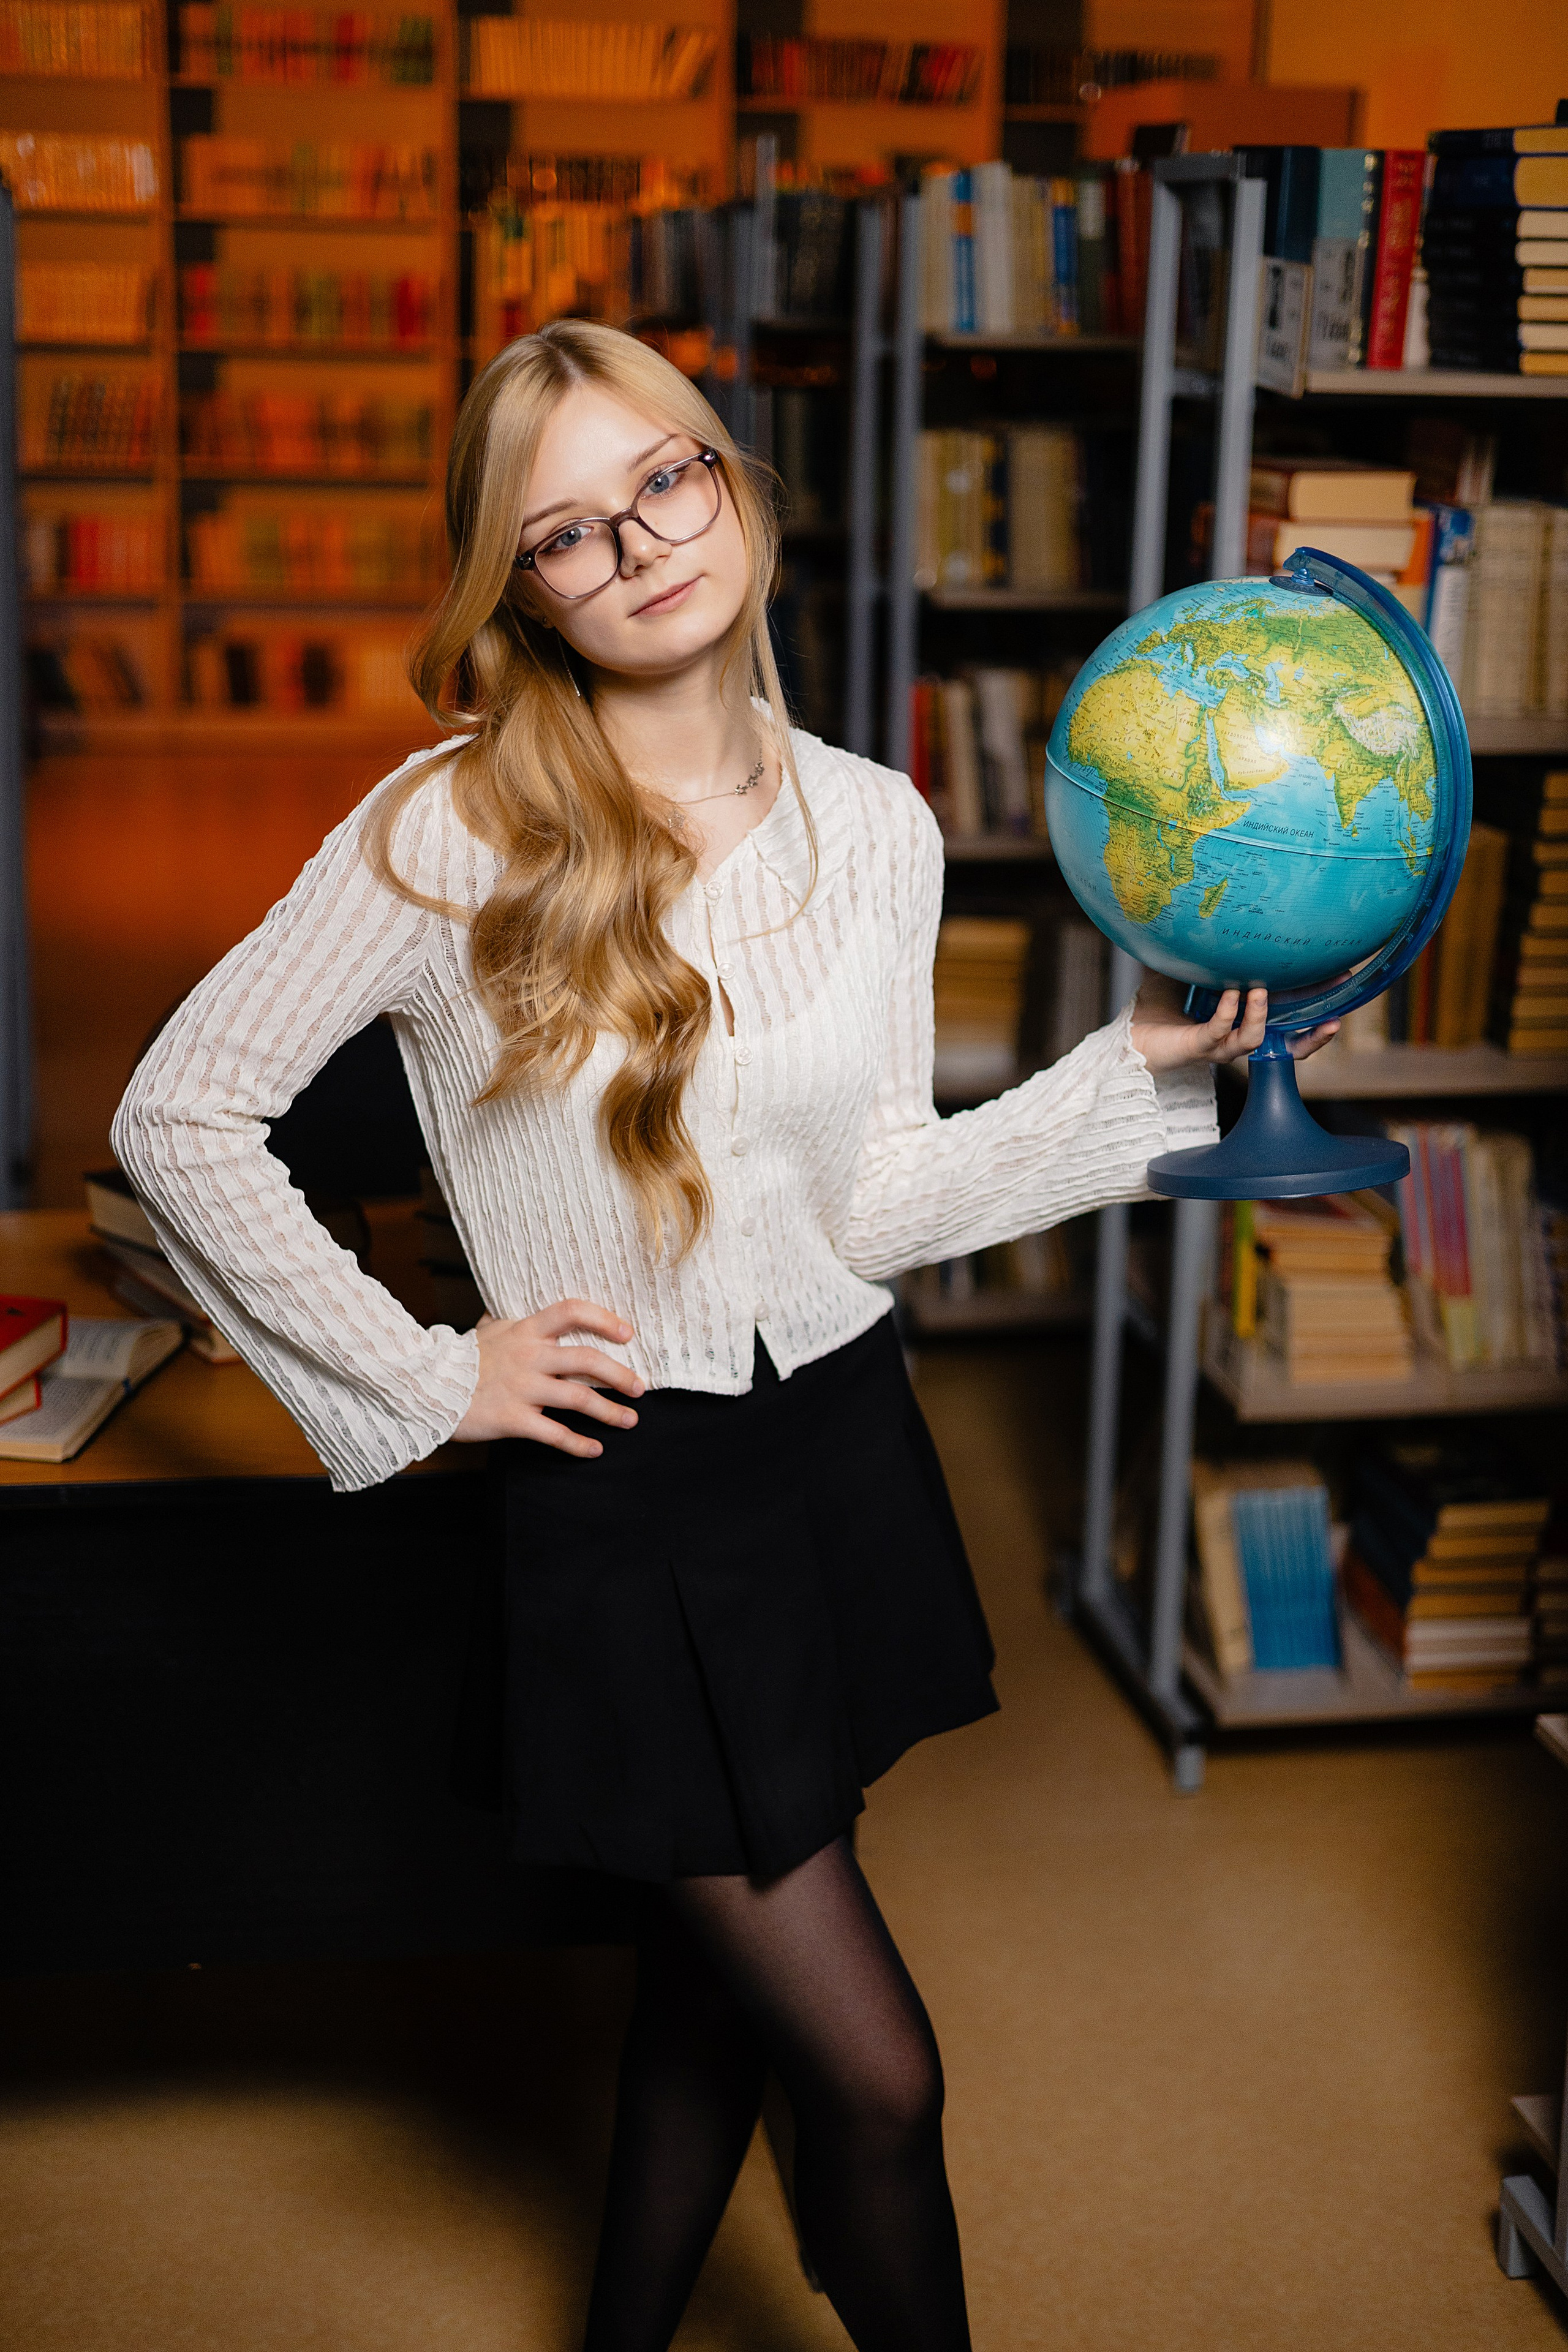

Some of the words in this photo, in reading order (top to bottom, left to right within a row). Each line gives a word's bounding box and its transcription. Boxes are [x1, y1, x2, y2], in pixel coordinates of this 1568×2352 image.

[1150, 697, 1175, 709] ЛИВИЯ
[1180, 718, 1201, 728] ЕГИПЕТ
[1243, 820, 1289, 834] ИНДИЙСКИЙ
[1290, 829, 1314, 838] ОКЕАН
[1222, 928, 1312, 946] ИНДИЙСКИЙ
